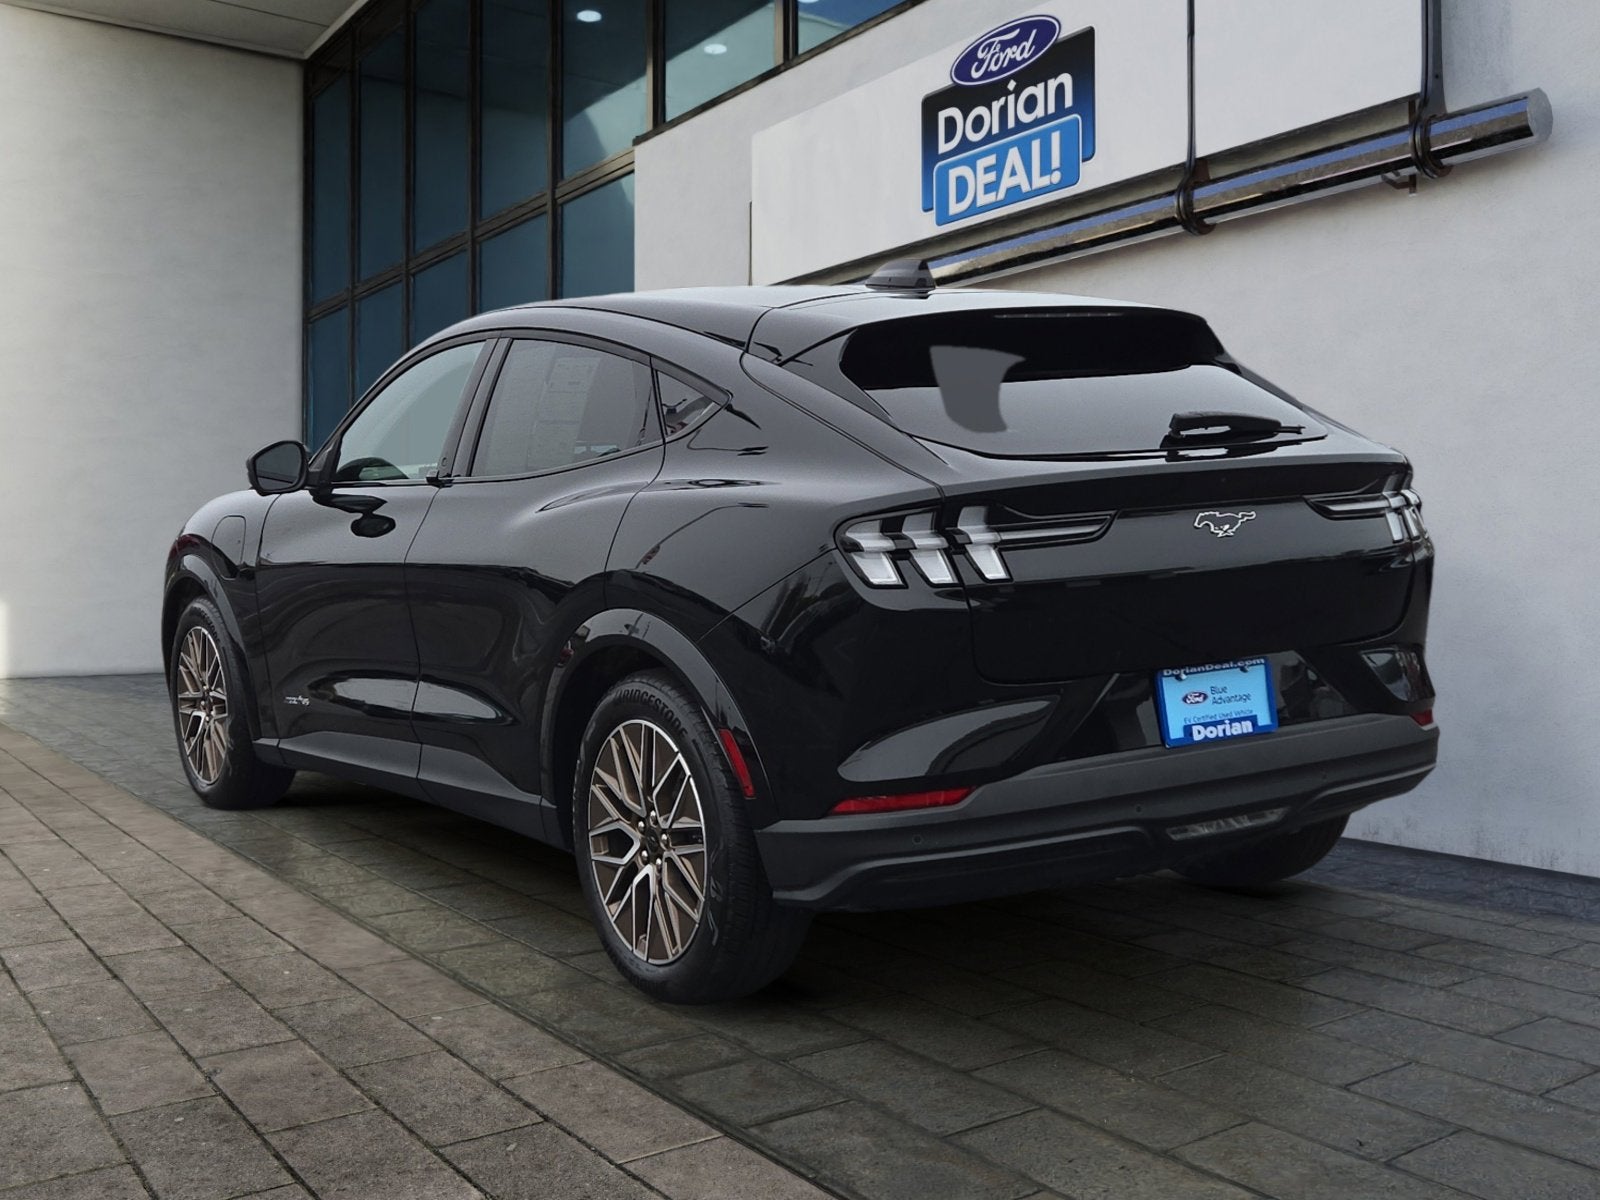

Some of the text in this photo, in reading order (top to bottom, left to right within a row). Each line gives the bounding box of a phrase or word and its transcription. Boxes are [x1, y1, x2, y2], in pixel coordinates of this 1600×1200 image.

[970, 28, 1038, 79] Ford
[938, 72, 1073, 155] Dorian
[948, 130, 1062, 216] DEAL!
[1163, 658, 1265, 676] DorianDeal.com
[1185, 692, 1206, 704] Ford
[1210, 686, 1228, 695] Blue
[1212, 692, 1252, 705] Advantage
[1192, 719, 1253, 741] Dorian
